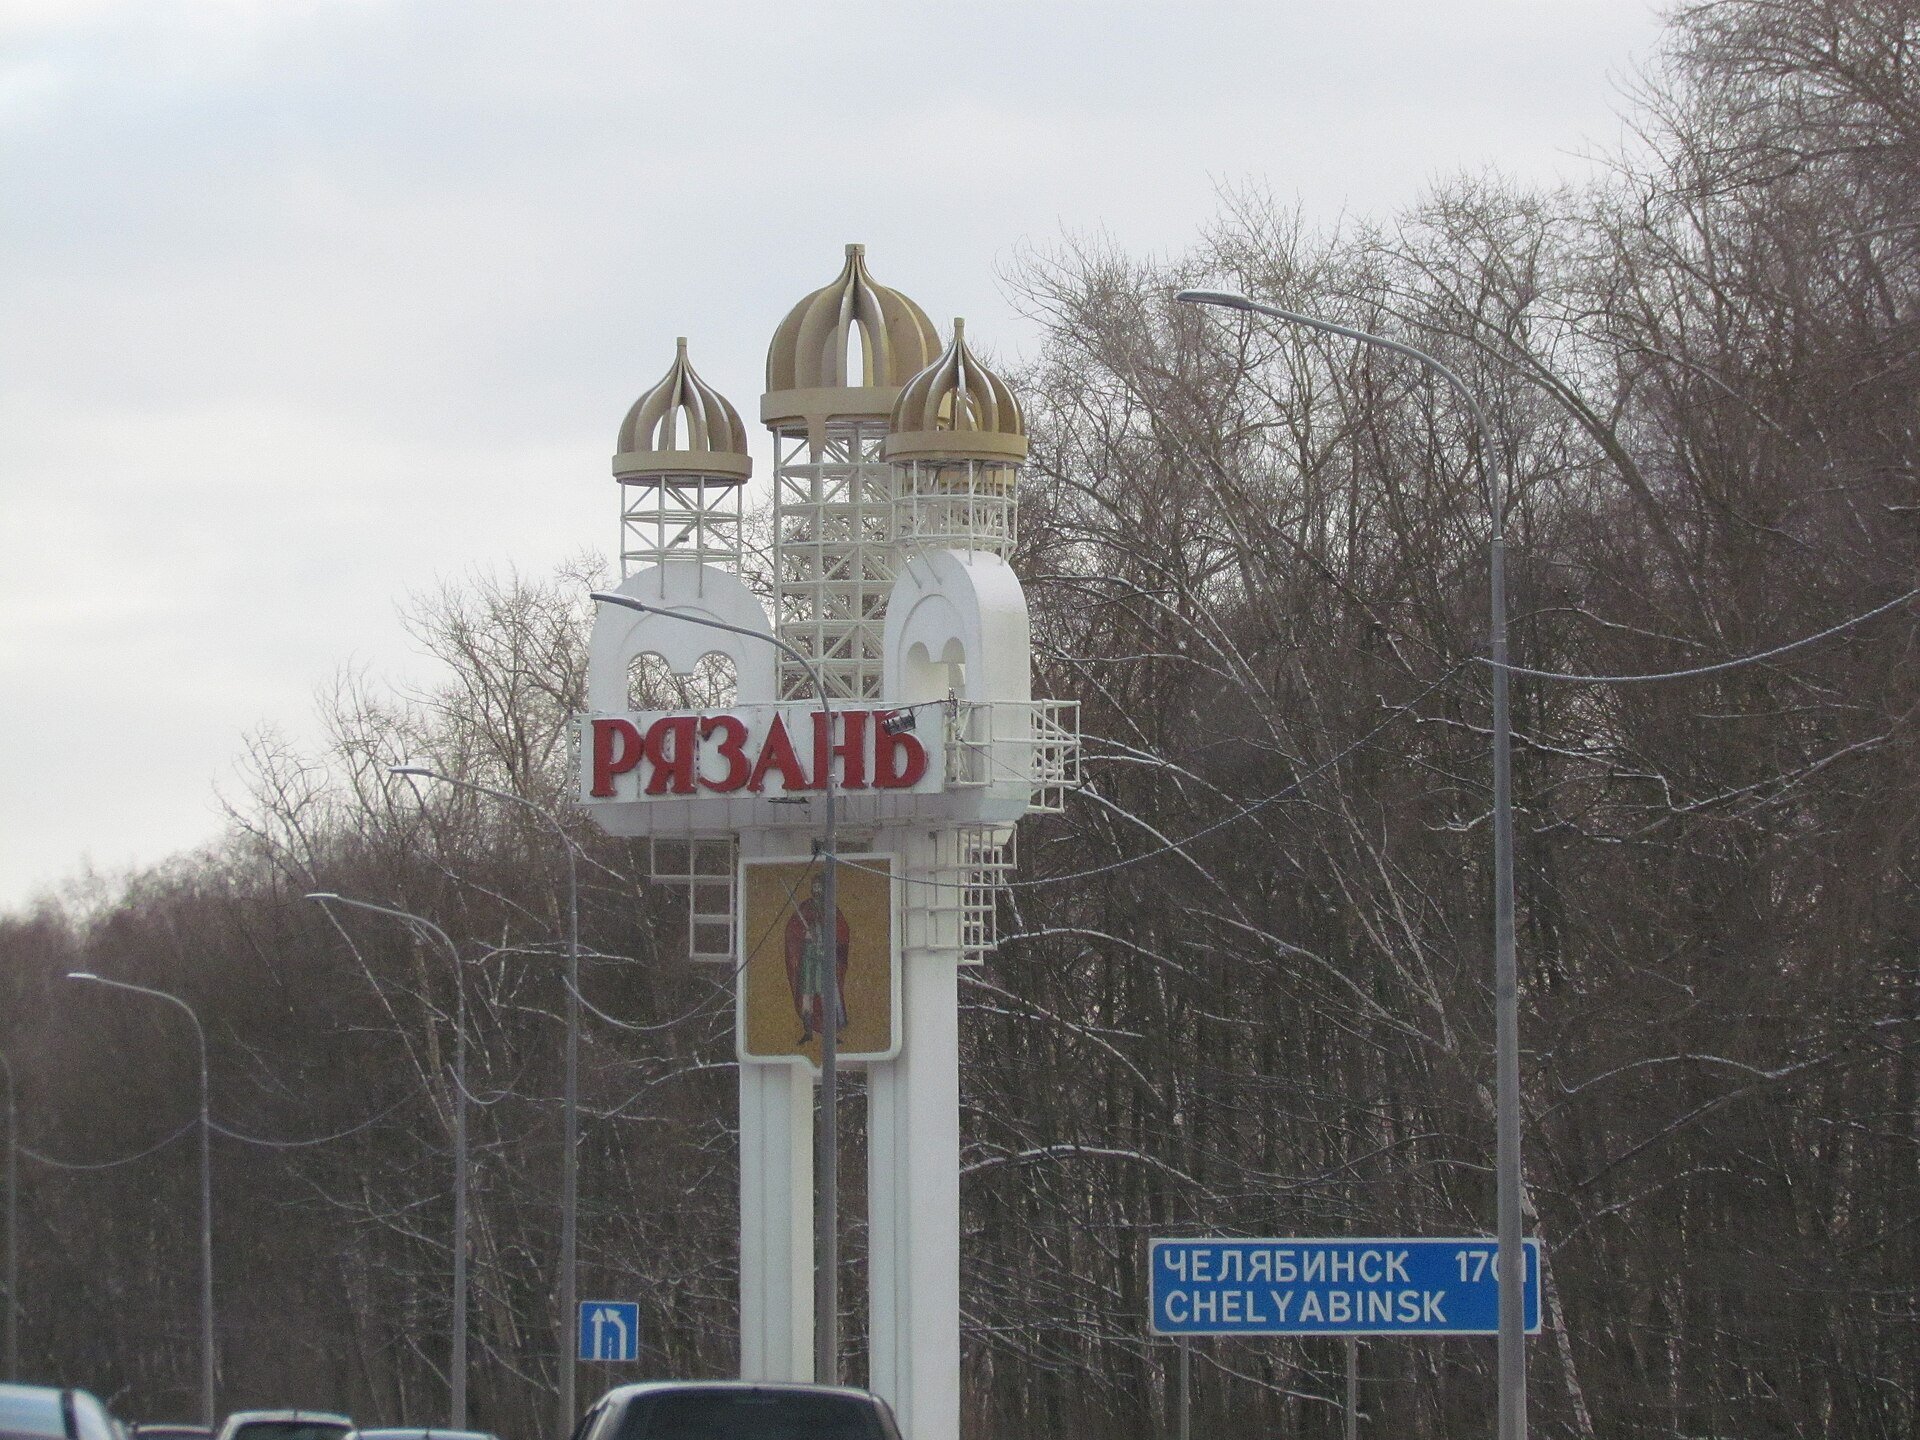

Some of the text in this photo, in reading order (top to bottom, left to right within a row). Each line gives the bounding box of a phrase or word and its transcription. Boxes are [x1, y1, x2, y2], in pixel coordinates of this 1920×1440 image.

[590, 711, 929, 797] РЯЗАНЬ
[1164, 1250, 1411, 1283] ЧЕЛЯБИНСК
[1165, 1290, 1447, 1323] CHELYABINSK
